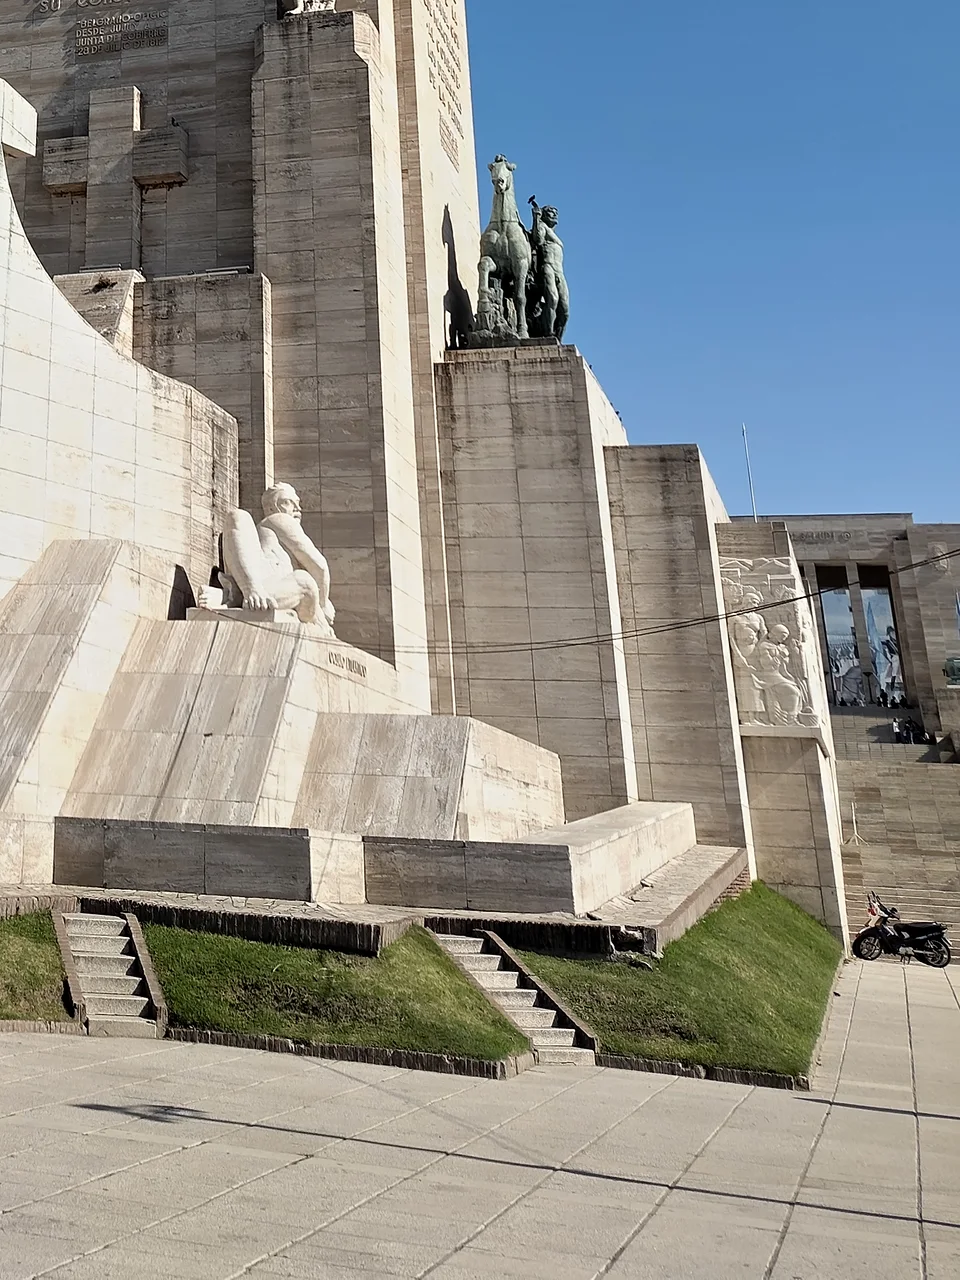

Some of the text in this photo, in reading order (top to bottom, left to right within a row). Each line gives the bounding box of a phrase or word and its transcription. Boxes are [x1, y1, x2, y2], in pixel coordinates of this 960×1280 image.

[76, 27, 105, 38] DESDE
[76, 28, 168, 47] JUNTA DE GOBIERNO
[91, 44, 103, 54] DE
[105, 41, 131, 52] JULIO
[133, 39, 145, 49] DE
